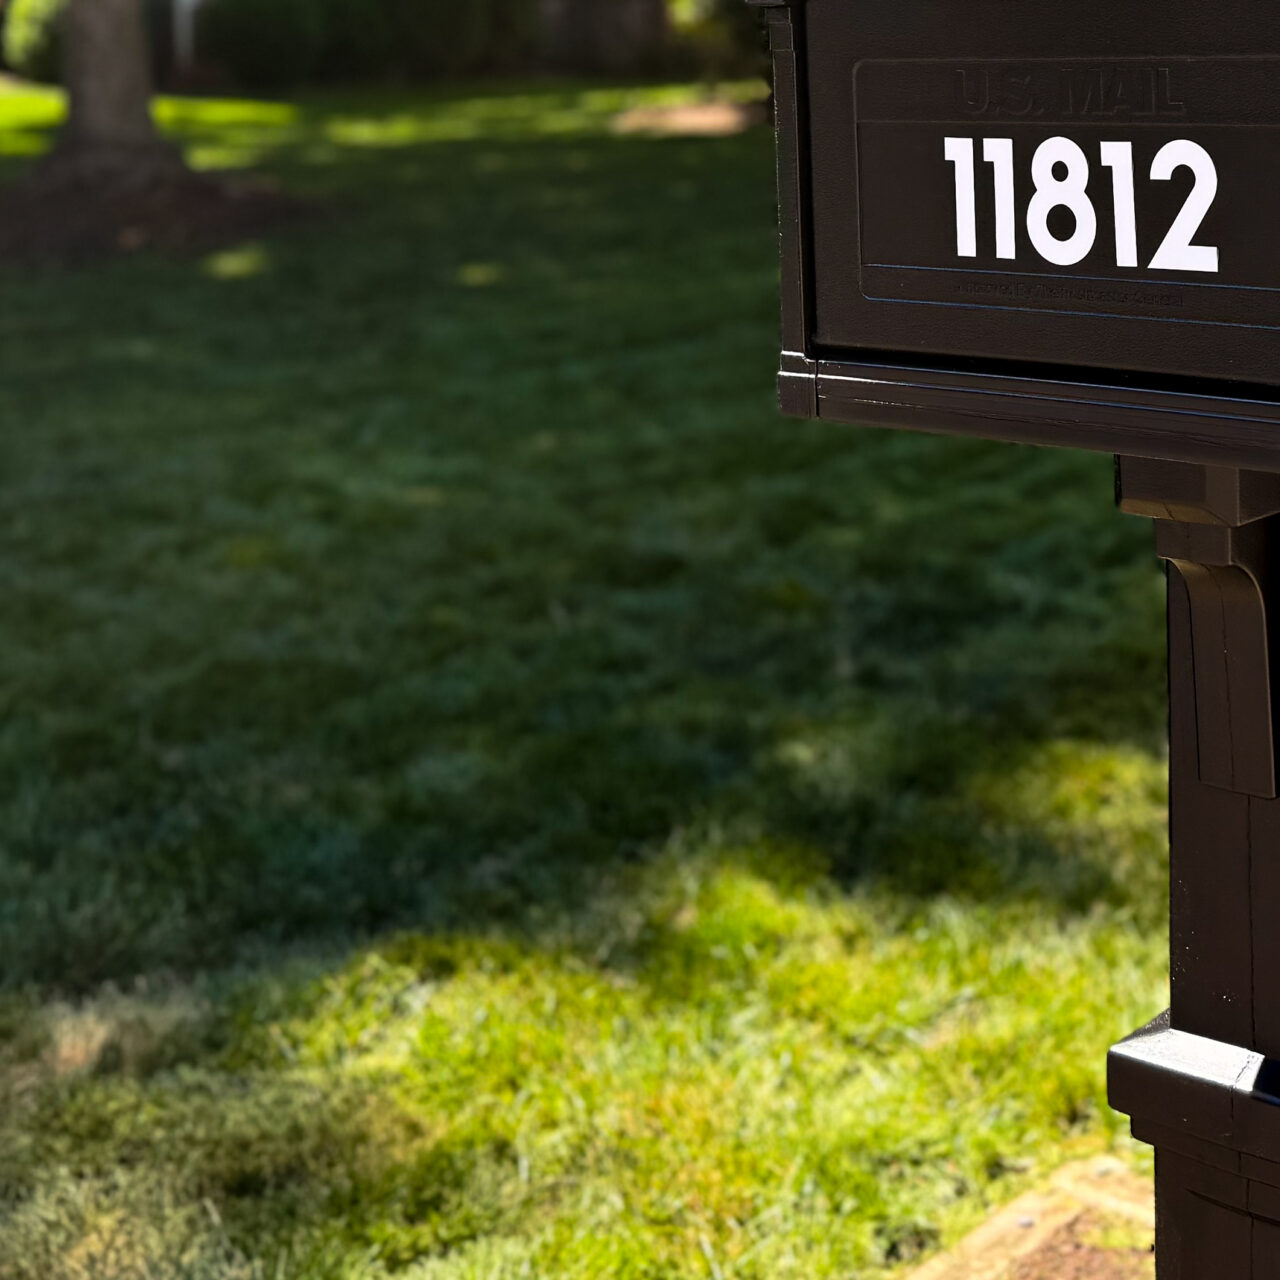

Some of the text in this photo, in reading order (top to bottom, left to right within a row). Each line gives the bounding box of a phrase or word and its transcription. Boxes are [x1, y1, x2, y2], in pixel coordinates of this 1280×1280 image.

[954, 67, 1187, 117] U.S. MAIL
[944, 136, 1219, 272] 11812
